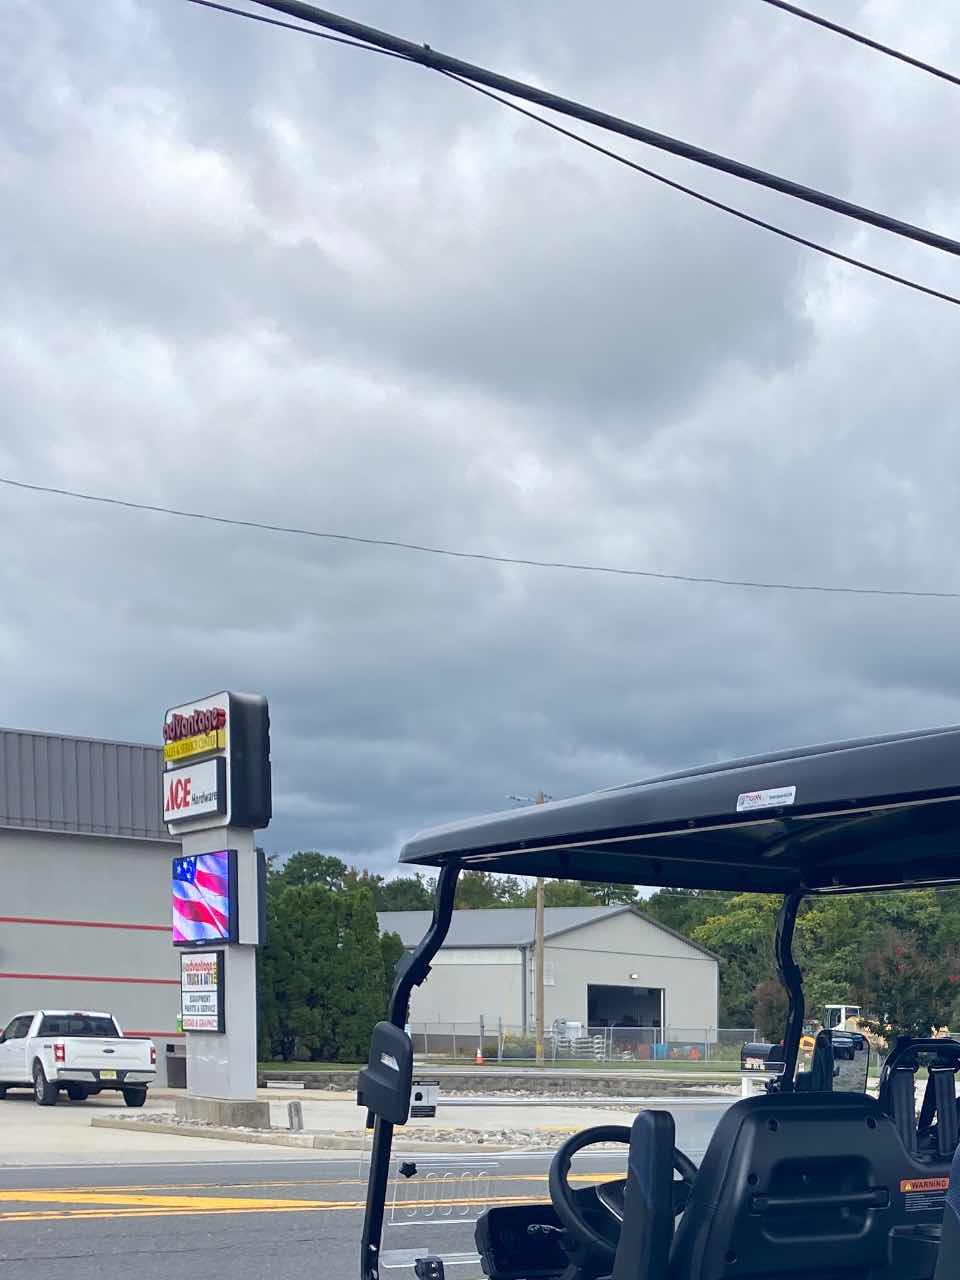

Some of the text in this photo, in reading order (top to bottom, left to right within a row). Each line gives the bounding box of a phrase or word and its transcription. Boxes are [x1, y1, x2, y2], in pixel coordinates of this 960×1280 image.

[163, 707, 225, 742] advantage
[165, 777, 220, 812] ACE Hardware
[912, 1179, 948, 1189] WARNING
